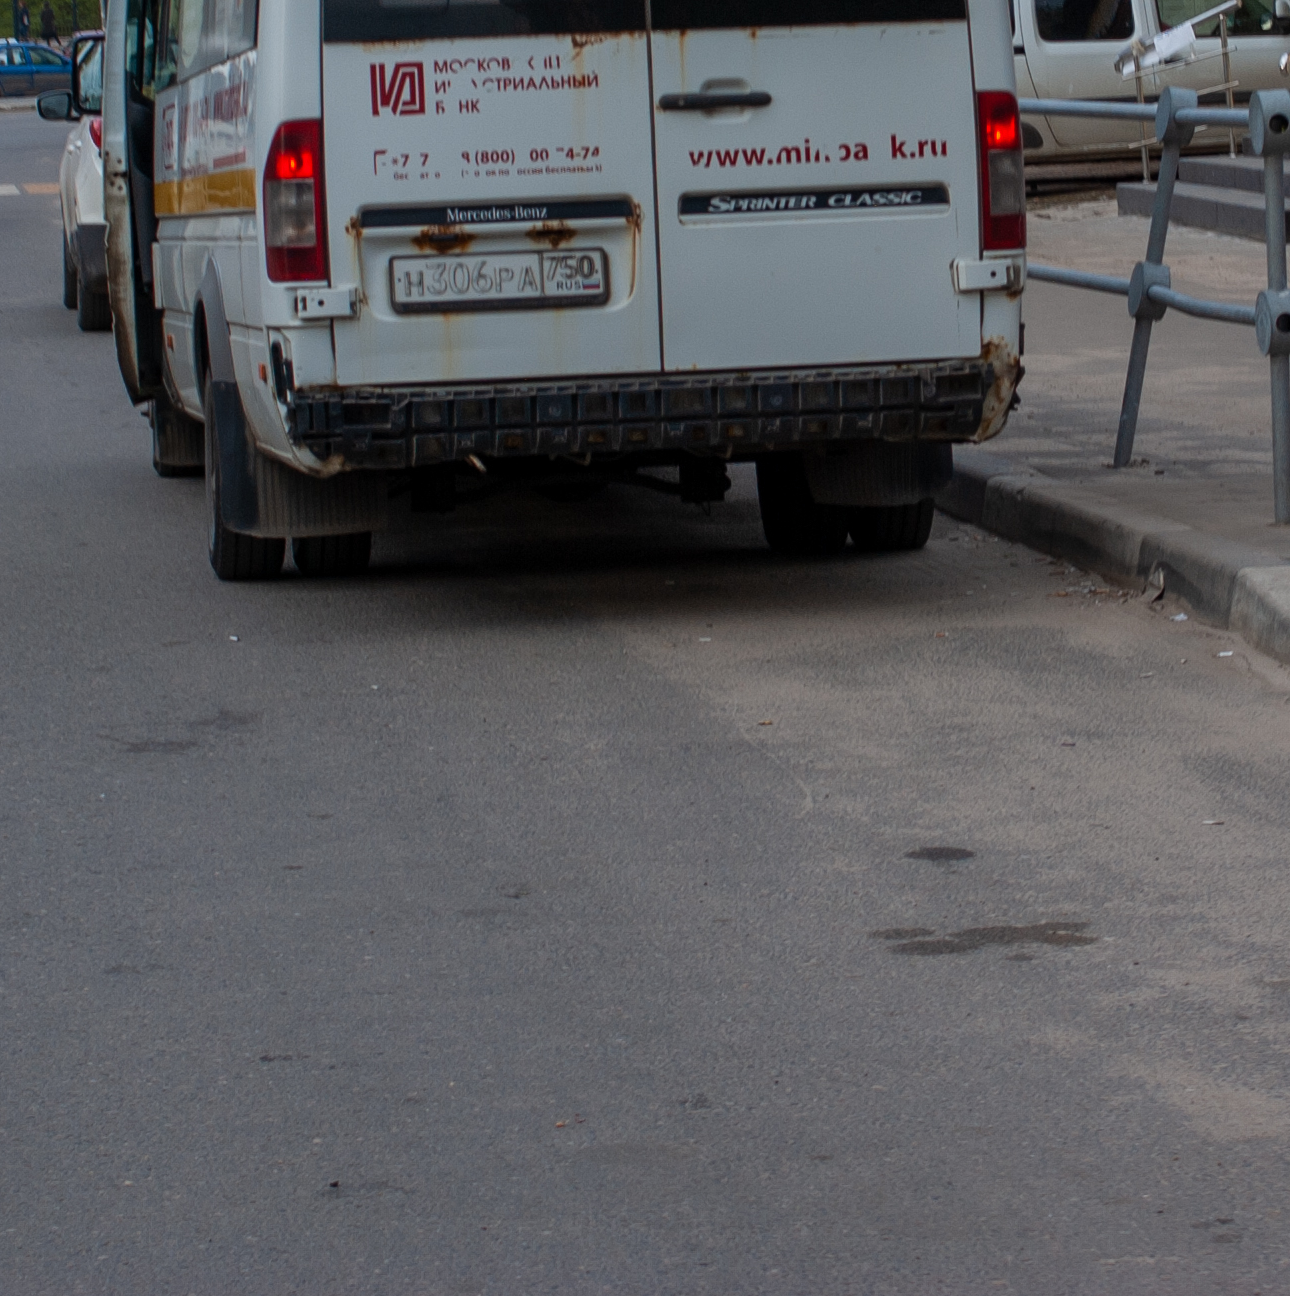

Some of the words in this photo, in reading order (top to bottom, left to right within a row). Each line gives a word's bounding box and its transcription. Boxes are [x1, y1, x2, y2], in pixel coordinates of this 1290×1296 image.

[435, 99, 481, 115] БНК
[474, 148, 516, 166] (800)
[707, 195, 817, 213] SPRINTER
[827, 190, 923, 207] CLASSIC
[446, 206, 548, 222] Mercedes-Benz
[404, 260, 539, 298] Н306РА
[542, 255, 596, 283] 750
[556, 279, 581, 291] RUS
